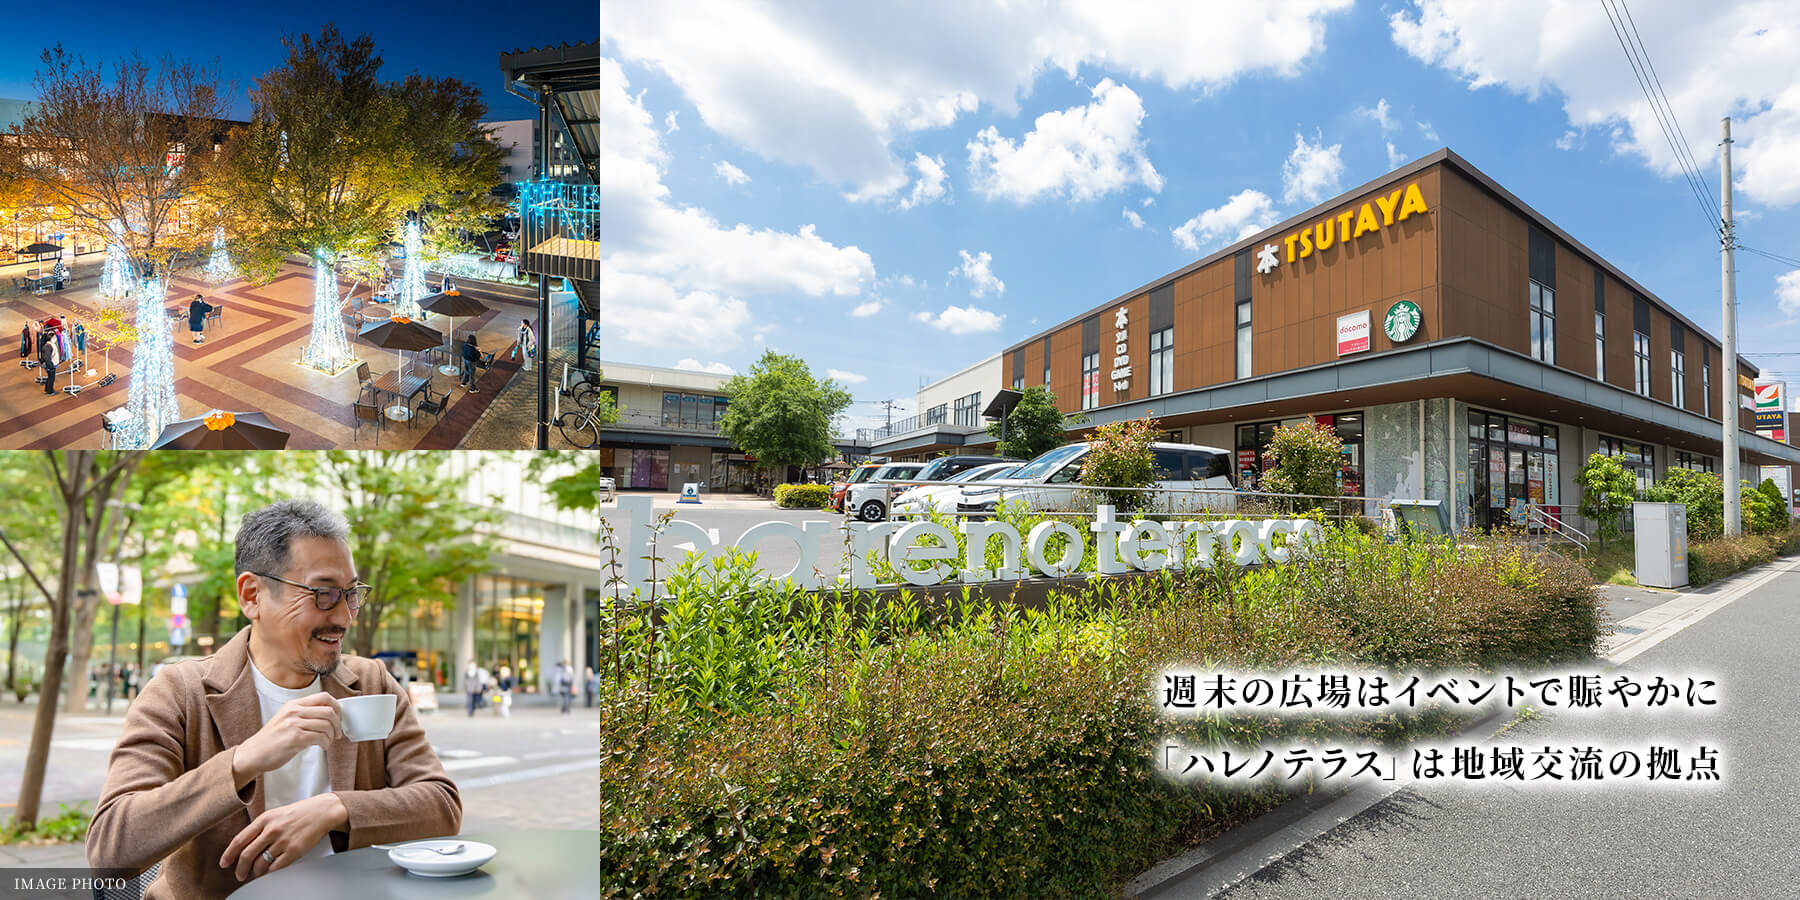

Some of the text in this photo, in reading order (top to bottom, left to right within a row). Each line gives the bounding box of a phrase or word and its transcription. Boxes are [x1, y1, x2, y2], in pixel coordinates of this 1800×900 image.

[1256, 183, 1428, 274] 本 TSUTAYA
[1115, 306, 1129, 329] 本
[1339, 323, 1368, 335] docomo
[1111, 366, 1133, 381] GAME
[1756, 413, 1783, 421] UTAYA
